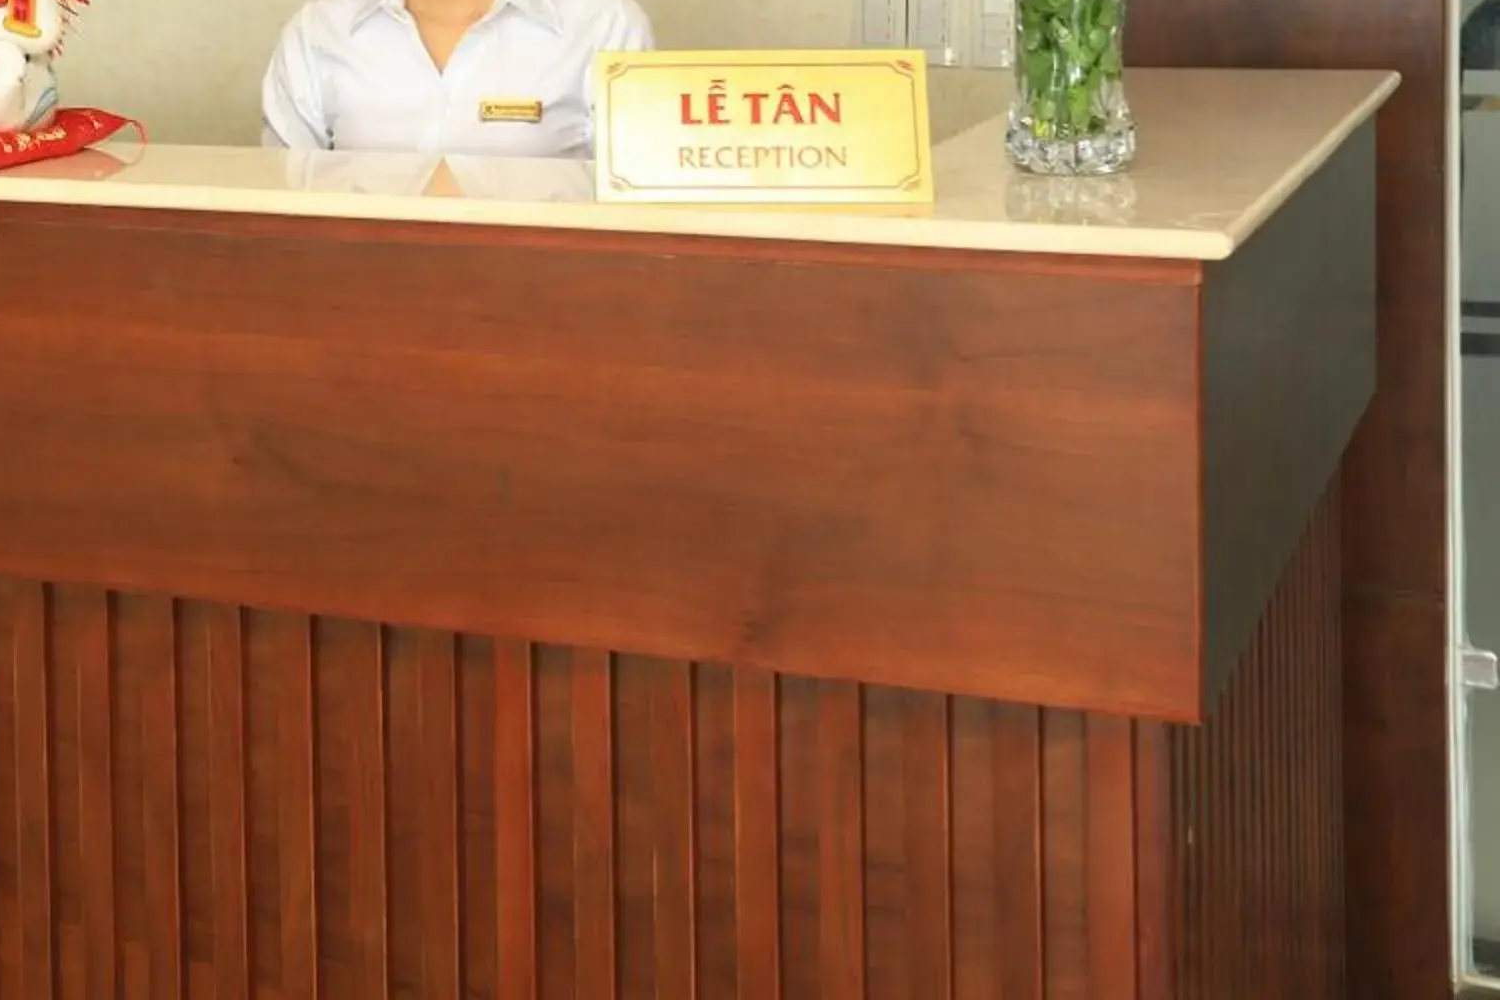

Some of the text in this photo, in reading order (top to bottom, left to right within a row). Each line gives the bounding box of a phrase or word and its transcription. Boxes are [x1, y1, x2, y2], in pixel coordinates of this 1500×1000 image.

[680, 77, 841, 125] LỄ TÂN
[678, 146, 847, 169] RECEPTION
